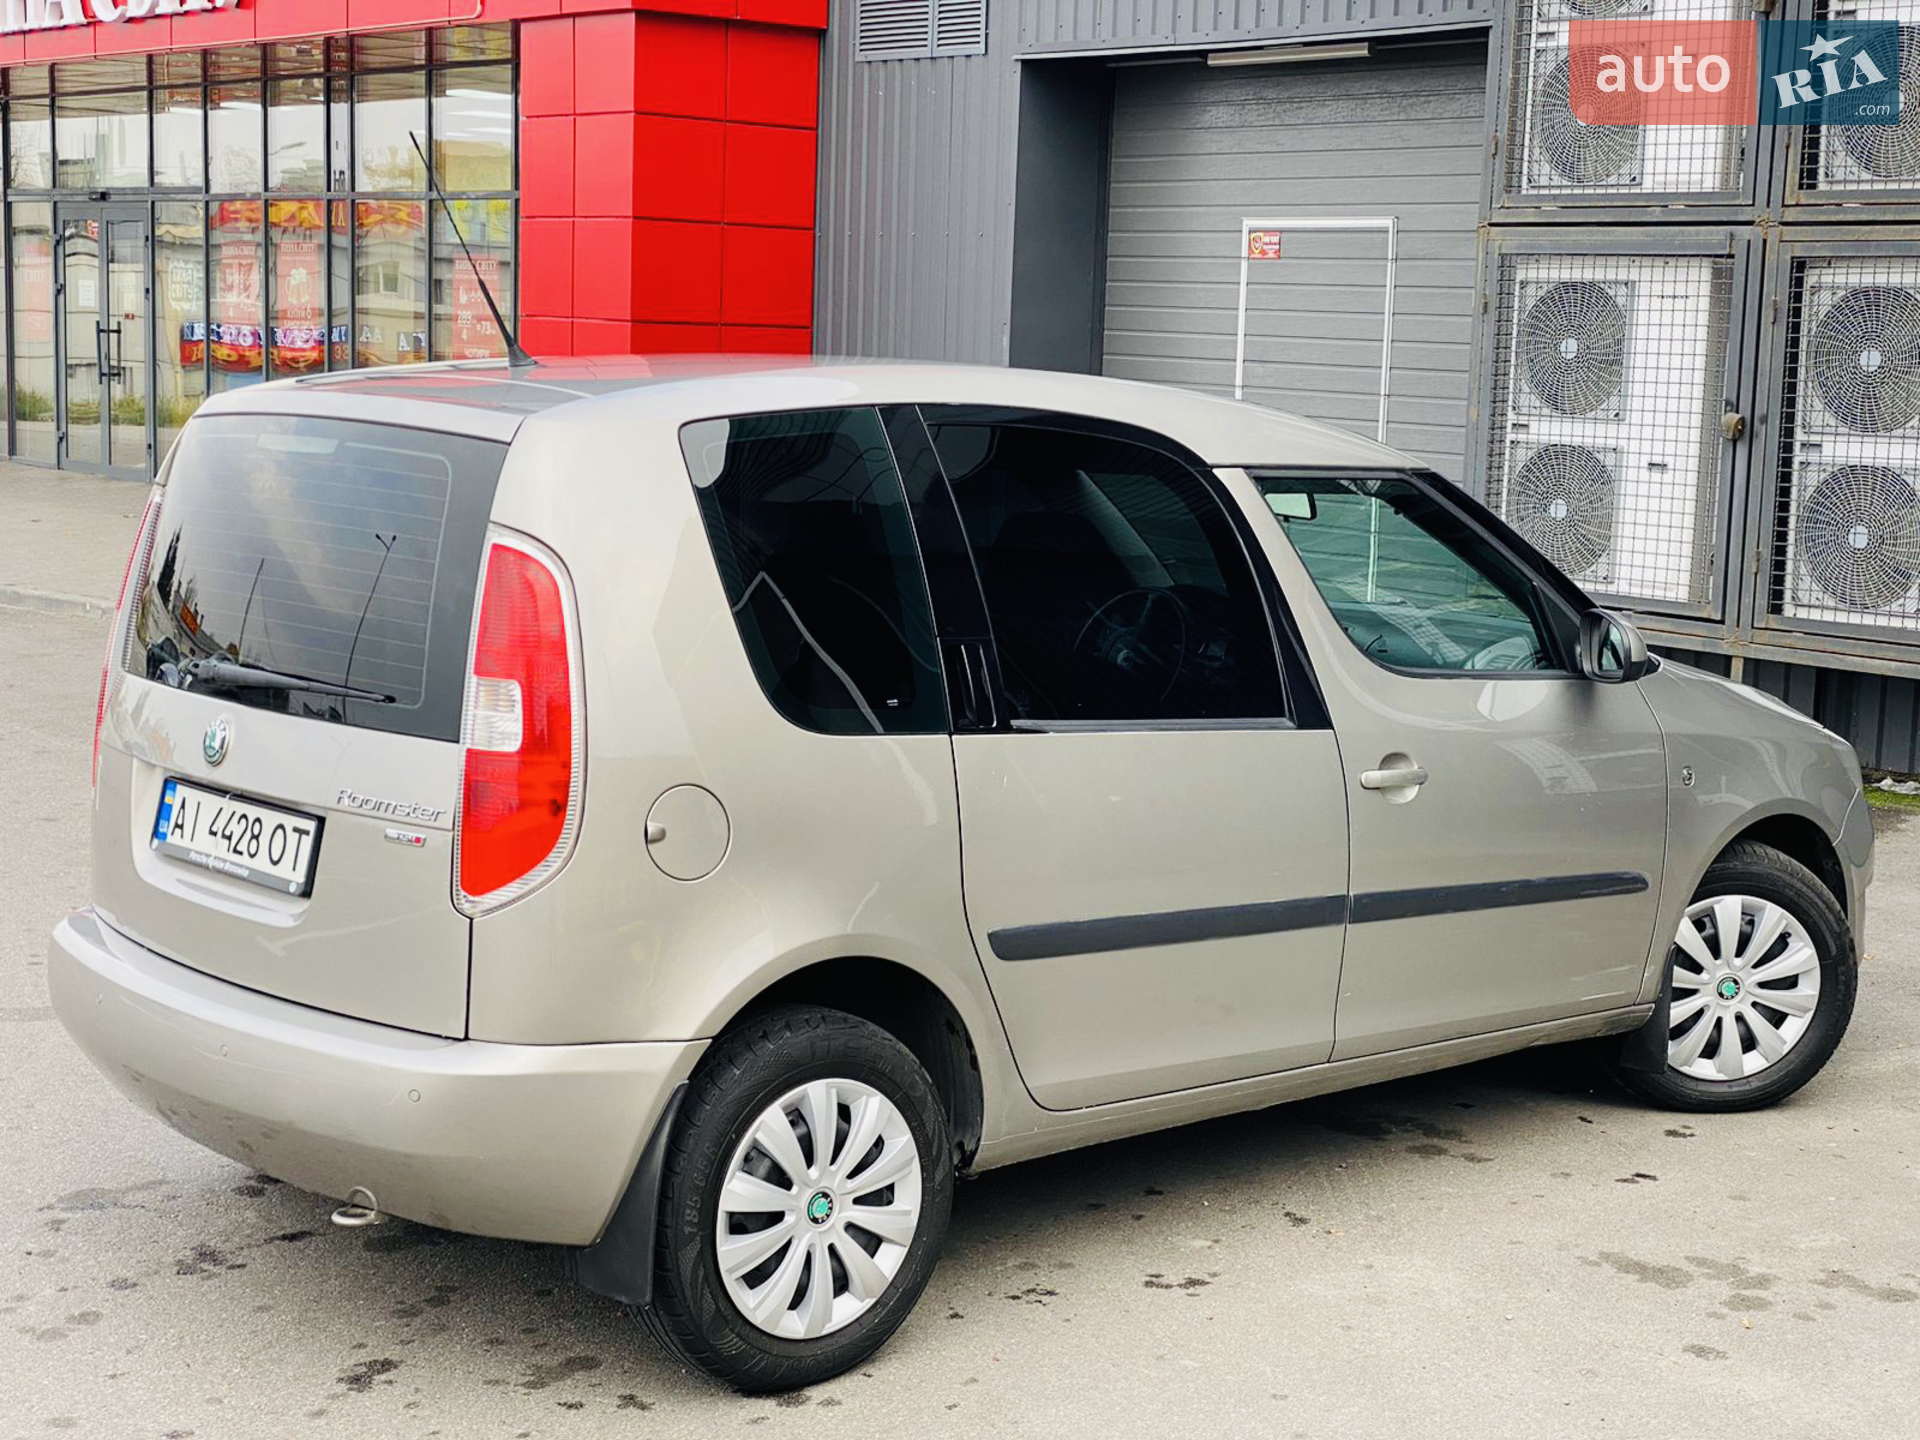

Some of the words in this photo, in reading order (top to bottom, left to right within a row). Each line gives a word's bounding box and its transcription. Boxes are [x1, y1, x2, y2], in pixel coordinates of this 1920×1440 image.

[337, 788, 447, 822] Roomster
[171, 797, 201, 842] AI
[208, 807, 263, 859] 4428
[268, 823, 310, 872] OT
